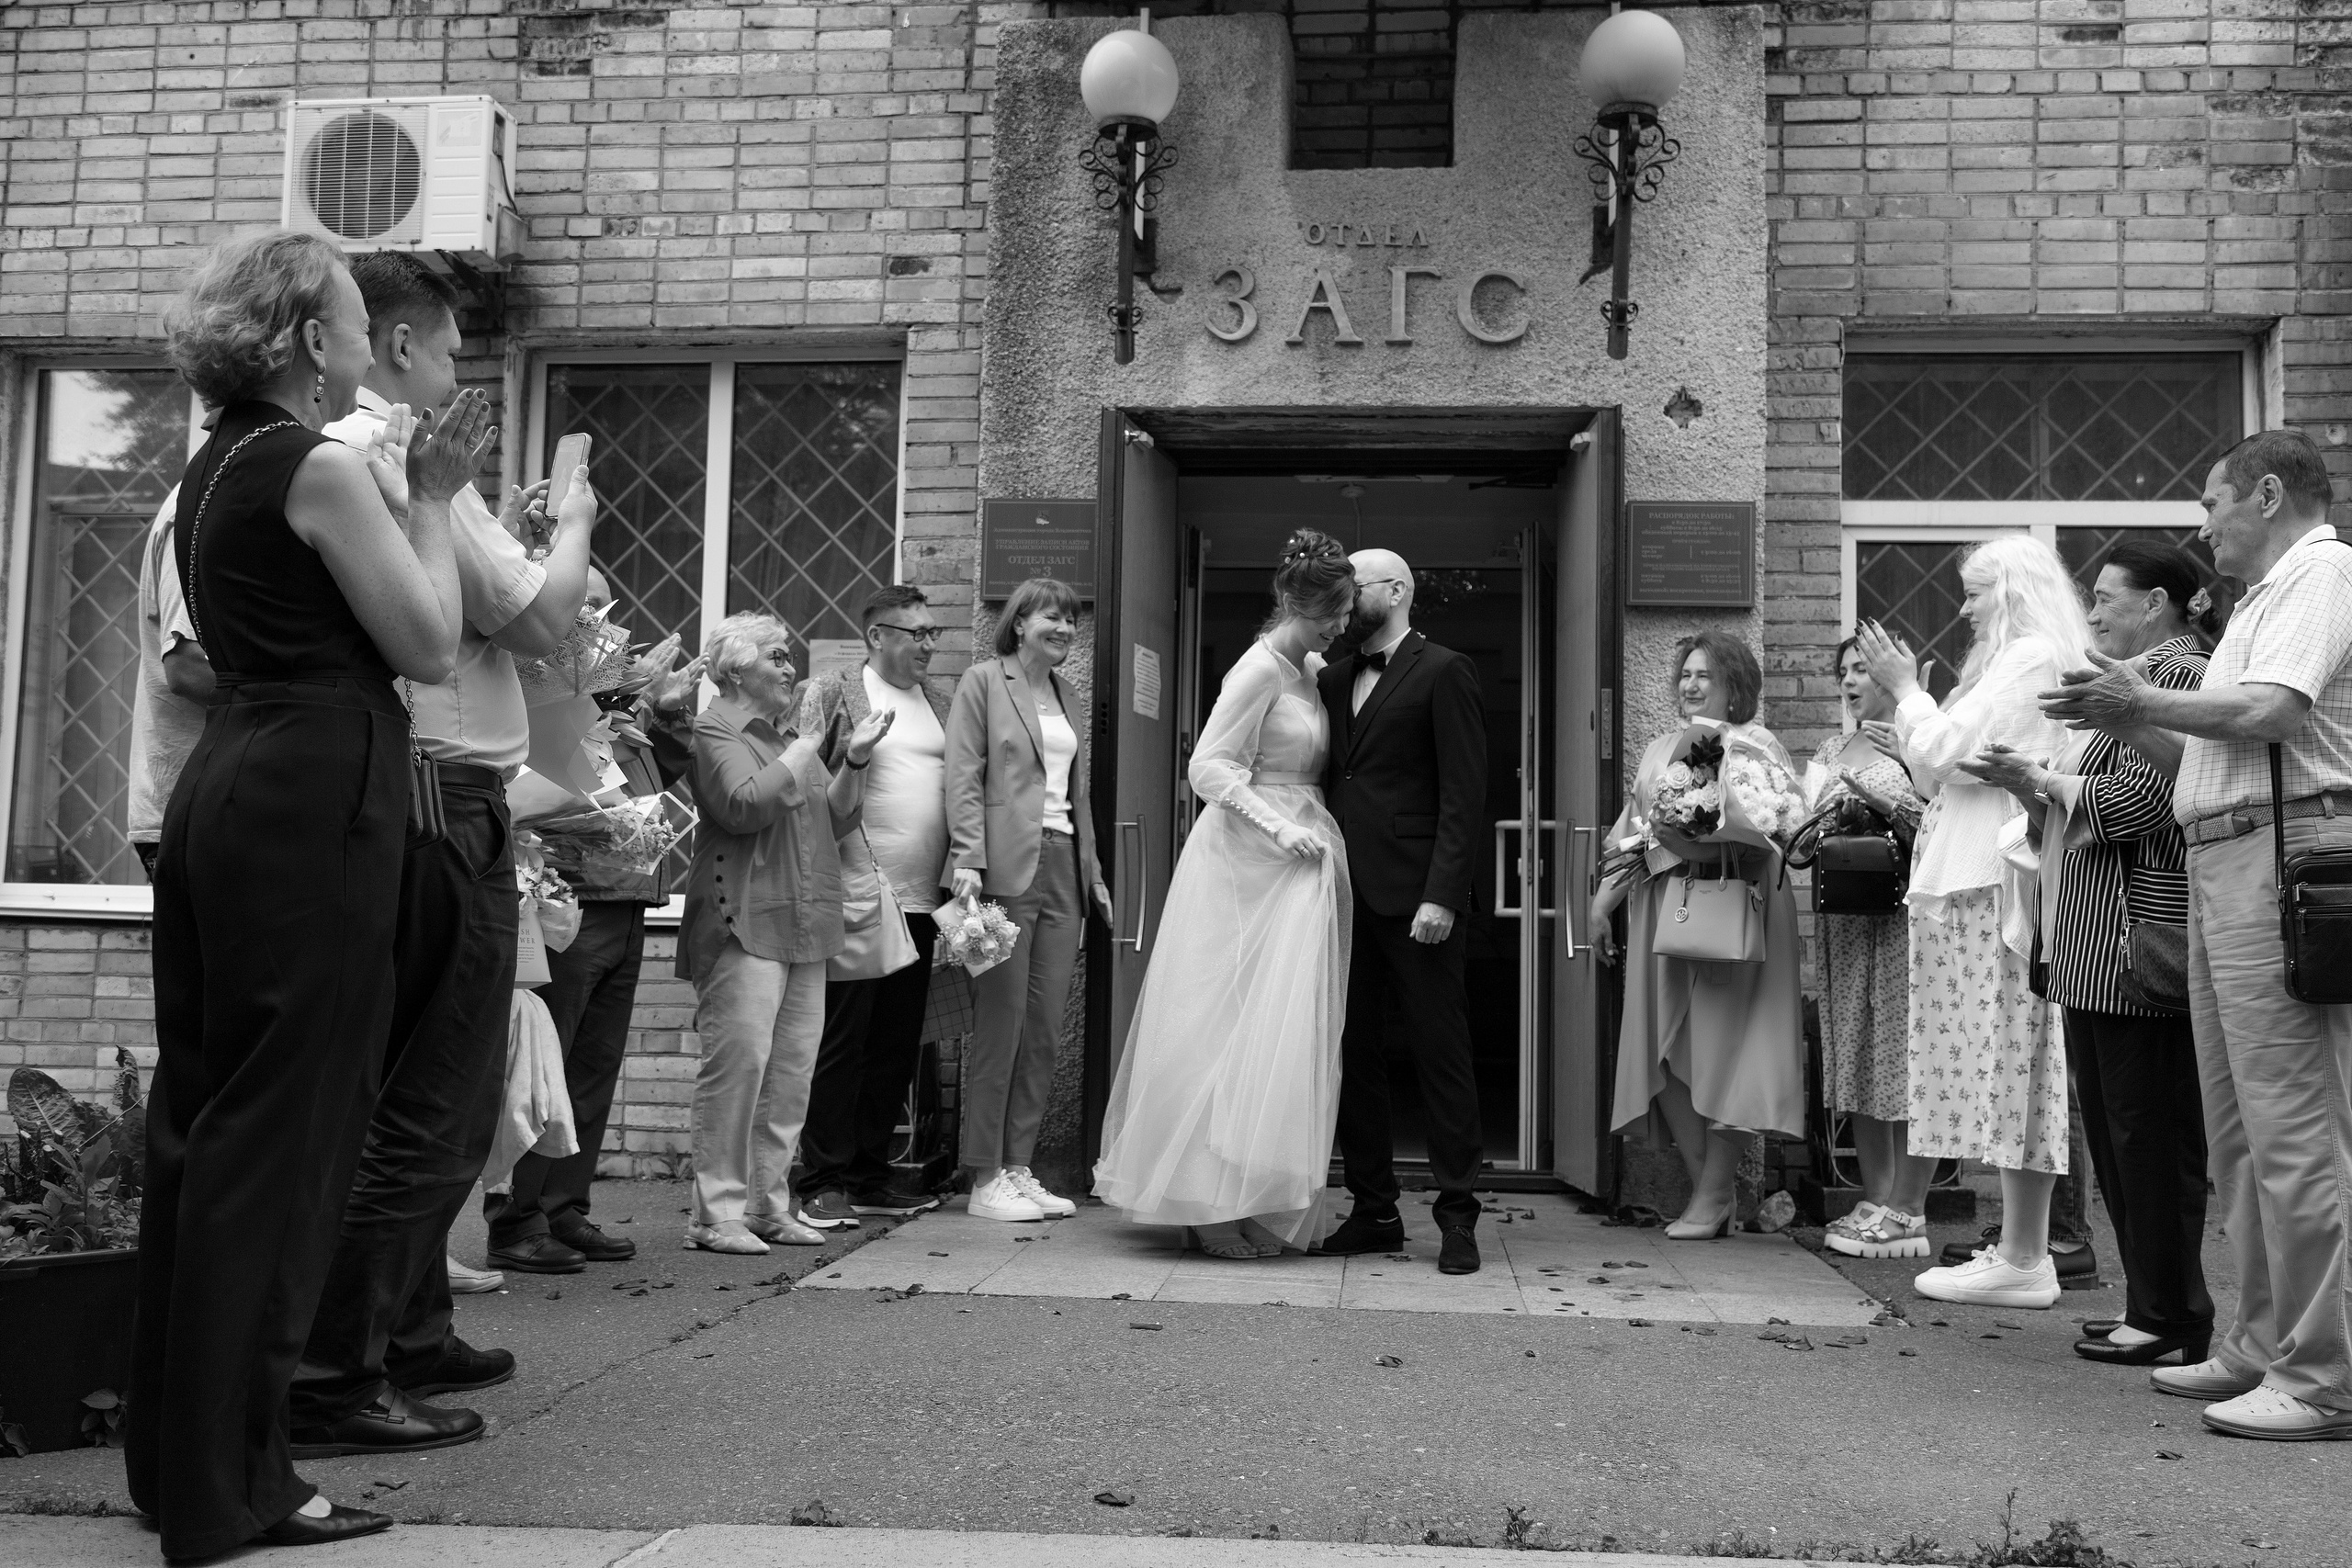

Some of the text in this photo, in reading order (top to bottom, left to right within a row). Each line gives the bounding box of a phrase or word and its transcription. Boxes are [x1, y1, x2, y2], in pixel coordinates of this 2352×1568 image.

[1303, 223, 1429, 248] ОТДЕЛ
[1204, 265, 1531, 346] ЗАГС
[1008, 556, 1075, 565] ОТДЕЛ ЗАГС
[1043, 566, 1052, 577] 3
